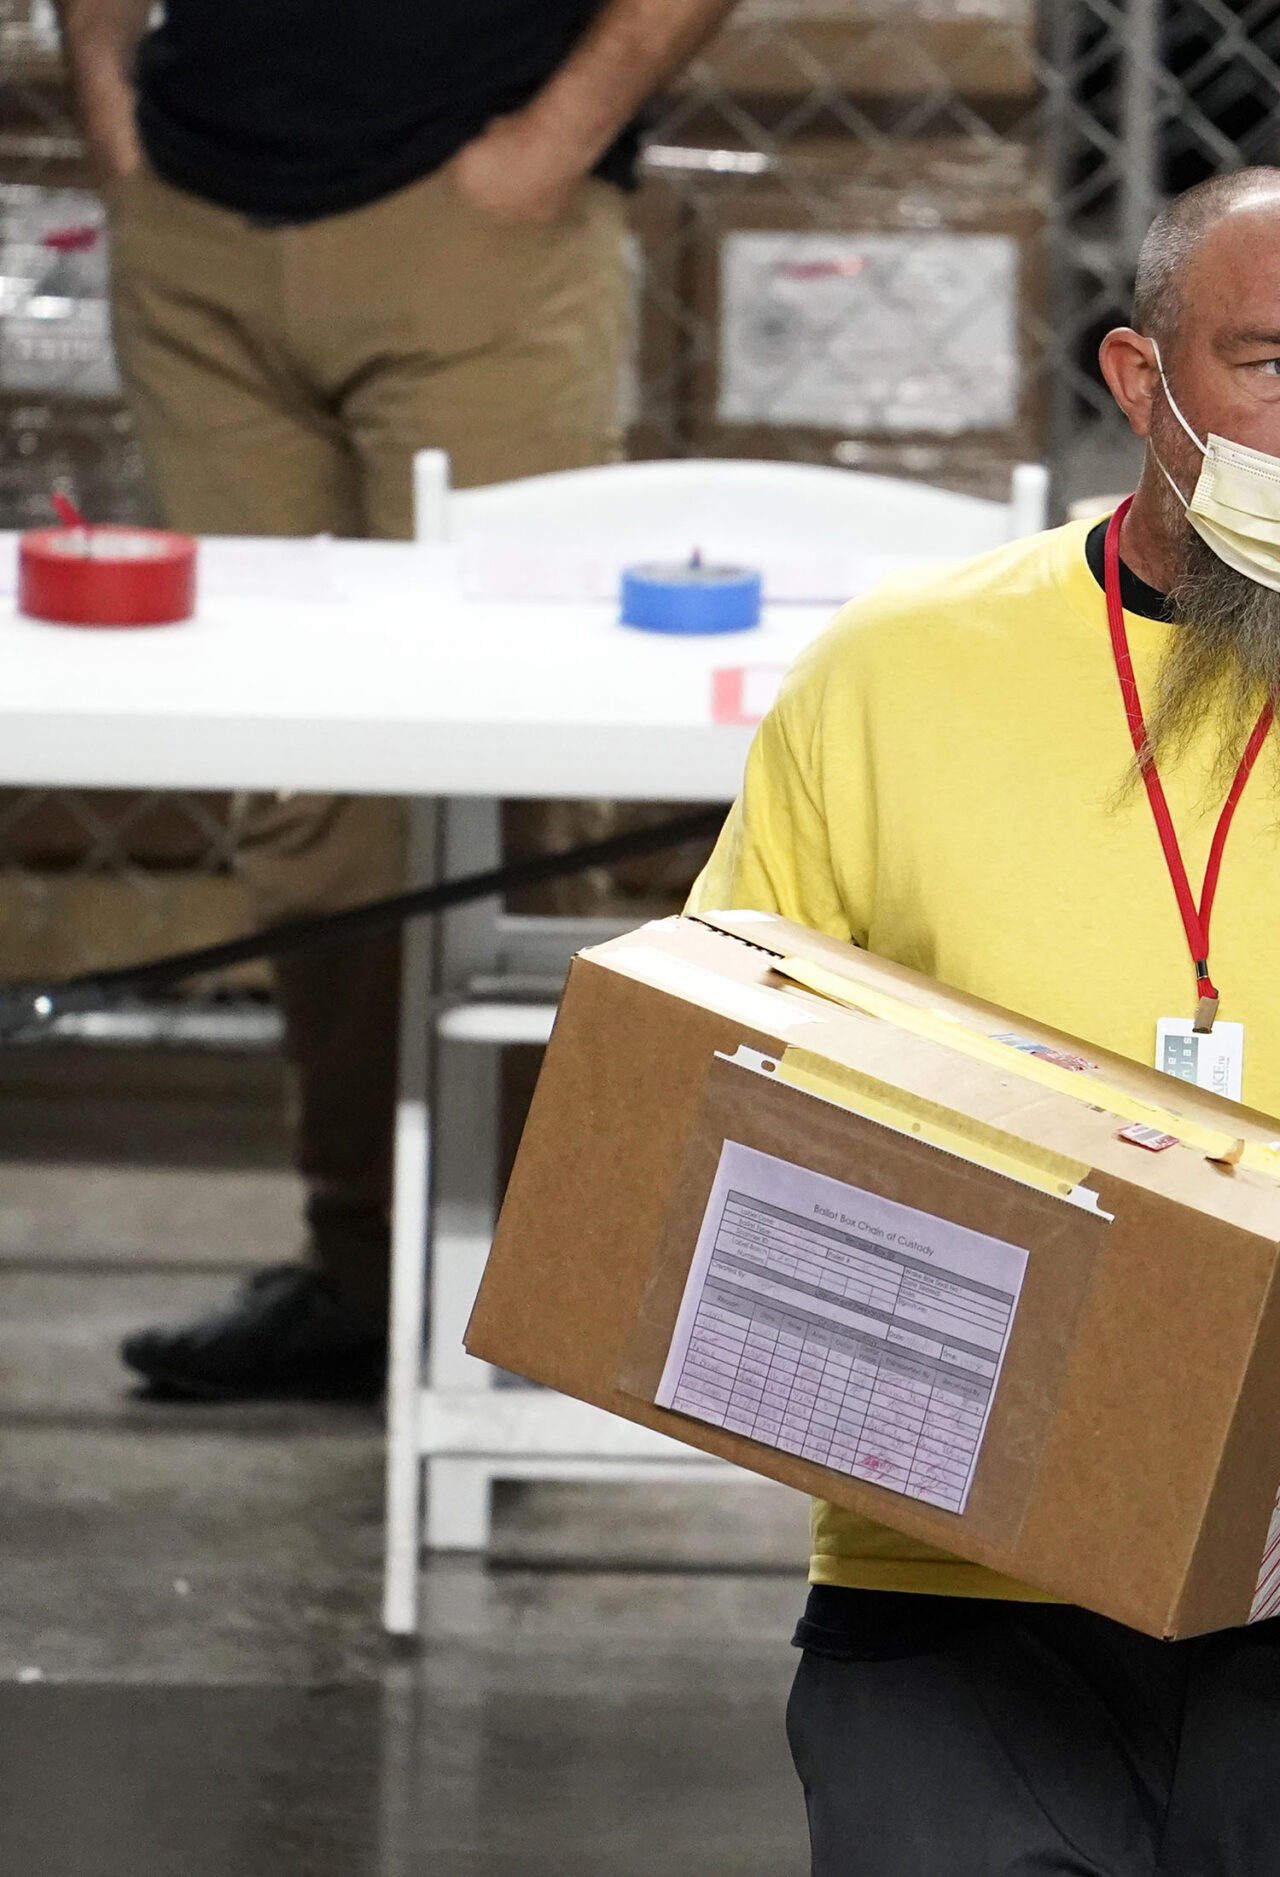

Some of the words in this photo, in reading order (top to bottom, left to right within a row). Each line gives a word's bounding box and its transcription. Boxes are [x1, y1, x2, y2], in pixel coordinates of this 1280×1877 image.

[813, 1204, 838, 1220] Ballot
[840, 1214, 856, 1227] Box
[857, 1221, 884, 1237] Chain
[886, 1233, 897, 1242] of
[897, 1236, 934, 1257] Custody
